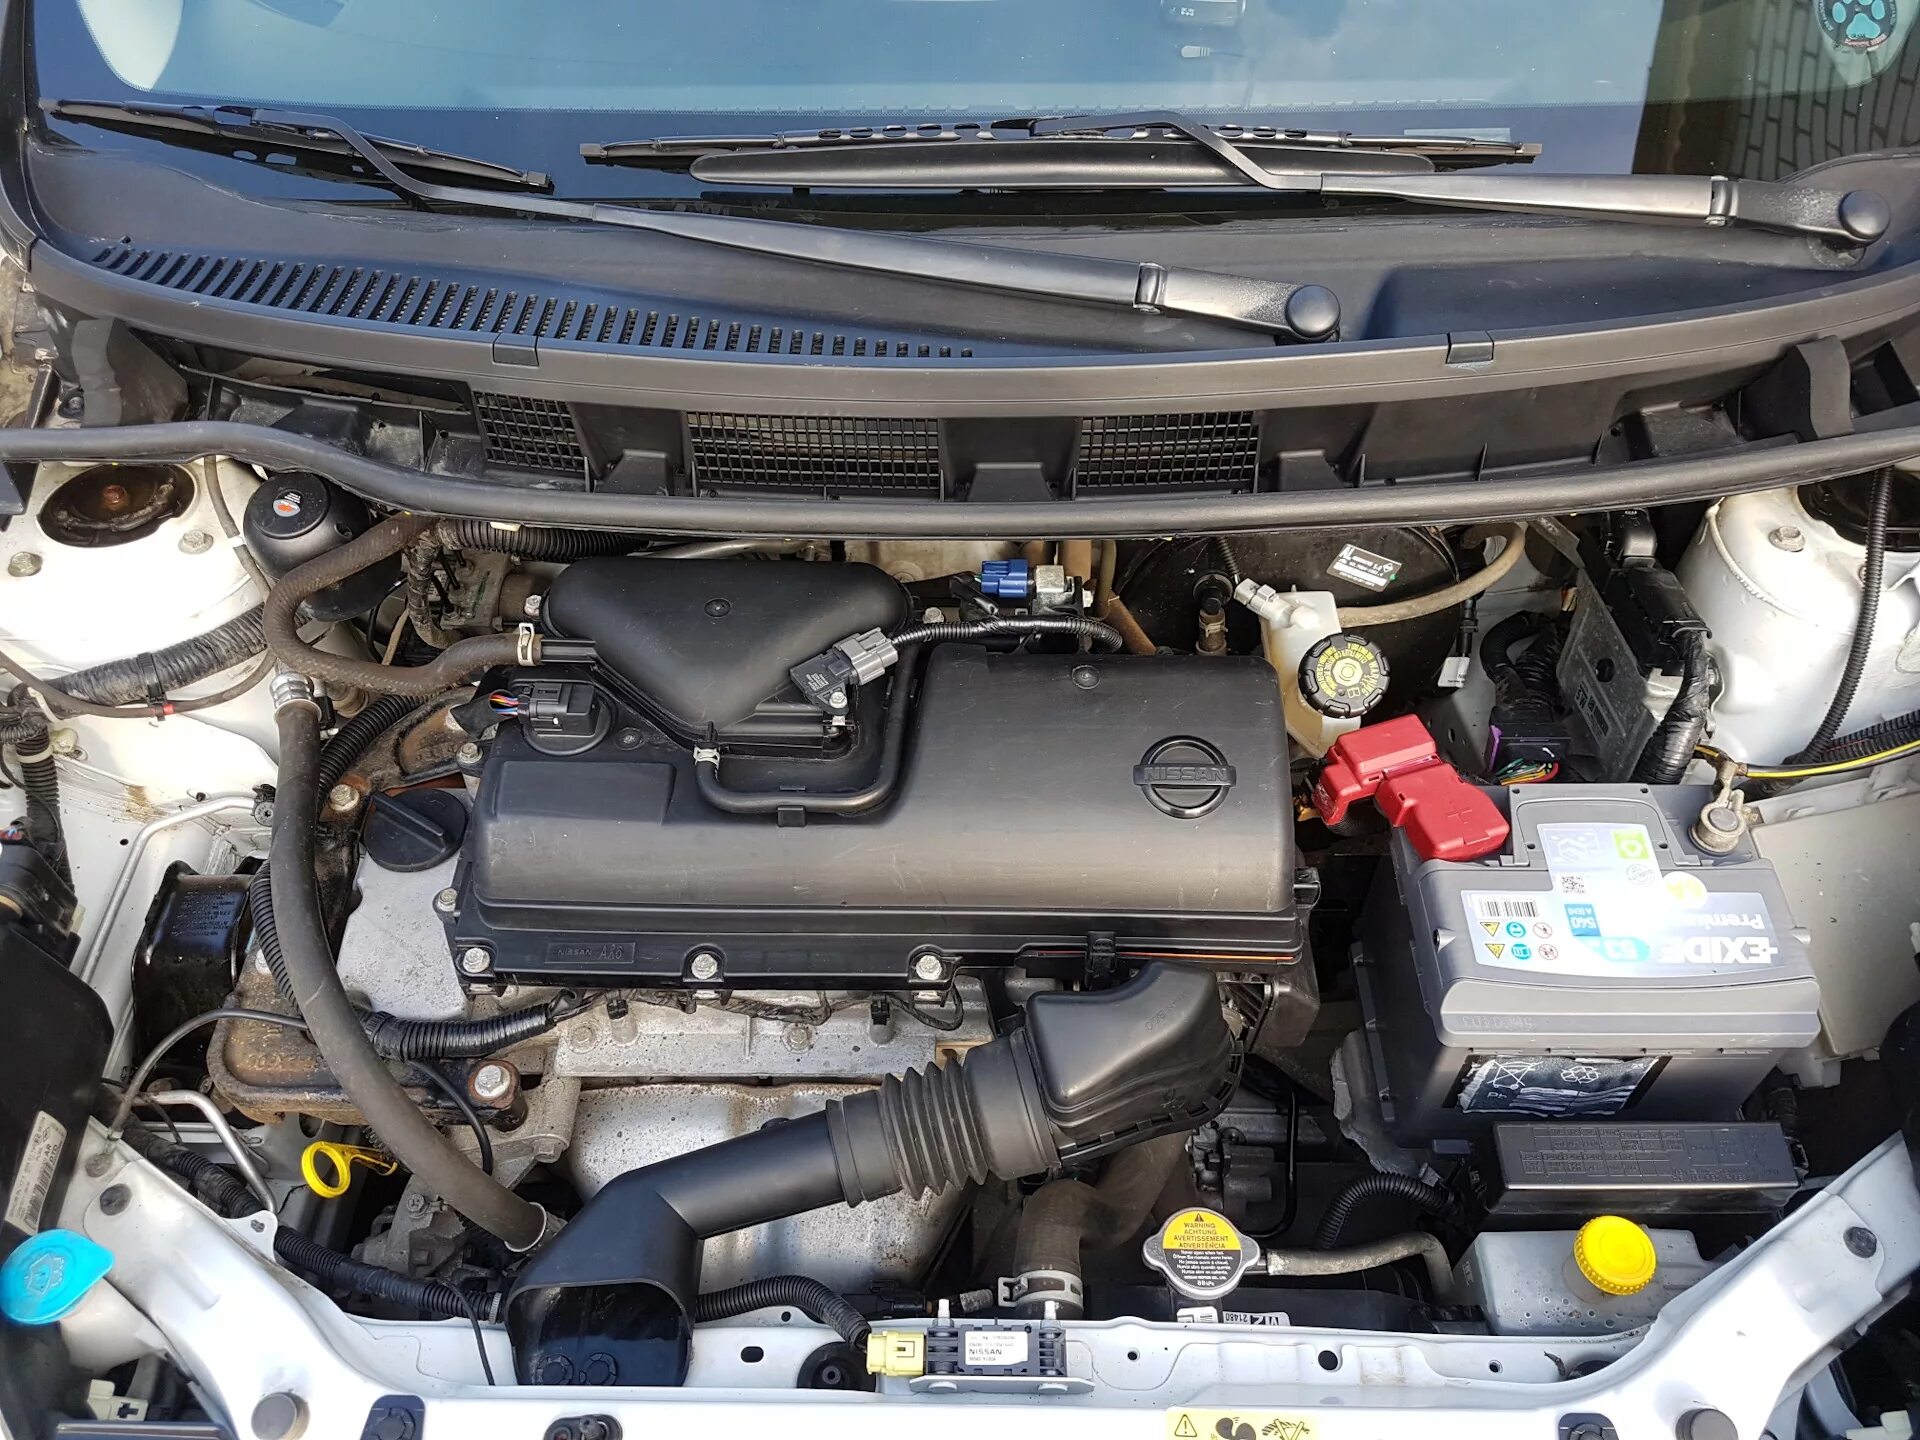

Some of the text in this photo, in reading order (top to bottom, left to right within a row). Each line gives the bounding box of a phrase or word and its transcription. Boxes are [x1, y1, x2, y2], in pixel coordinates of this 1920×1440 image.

[1361, 660, 1380, 696] WARNING
[1144, 766, 1227, 782] NISSAN
[1572, 917, 1596, 930] 560
[1684, 912, 1766, 932] Premiu
[1658, 937, 1778, 964] EXIDE
